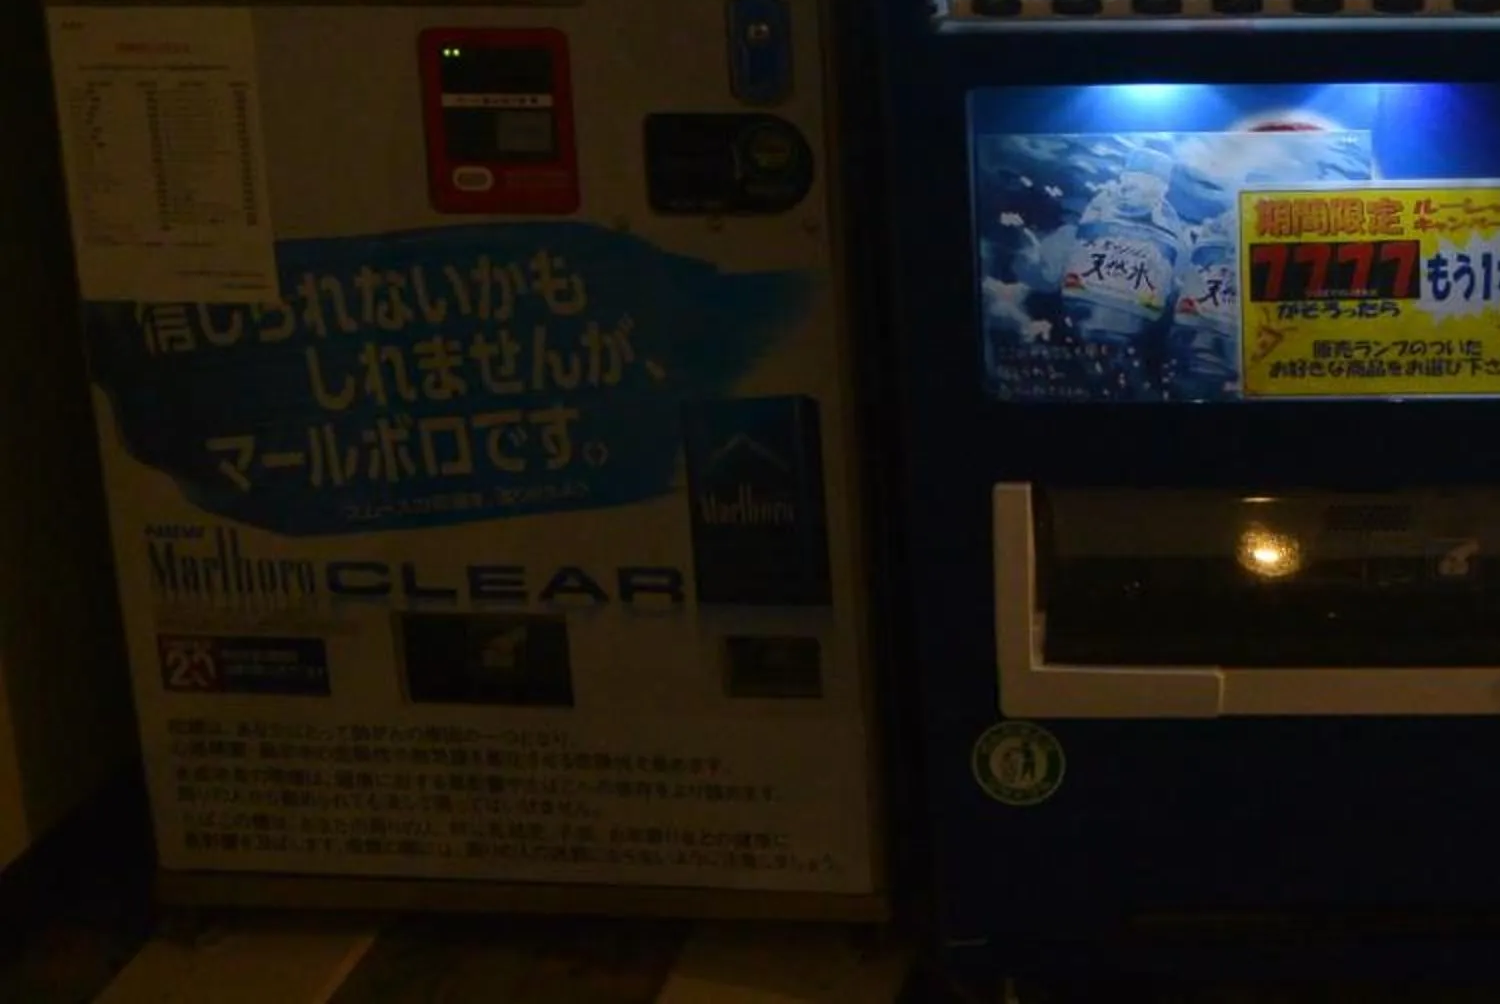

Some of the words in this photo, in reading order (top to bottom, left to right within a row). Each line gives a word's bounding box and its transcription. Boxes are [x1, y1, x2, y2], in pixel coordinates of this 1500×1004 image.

[1256, 196, 1405, 237] 期間限定
[1253, 241, 1418, 301] 7777
[324, 560, 687, 603] CLEAR
